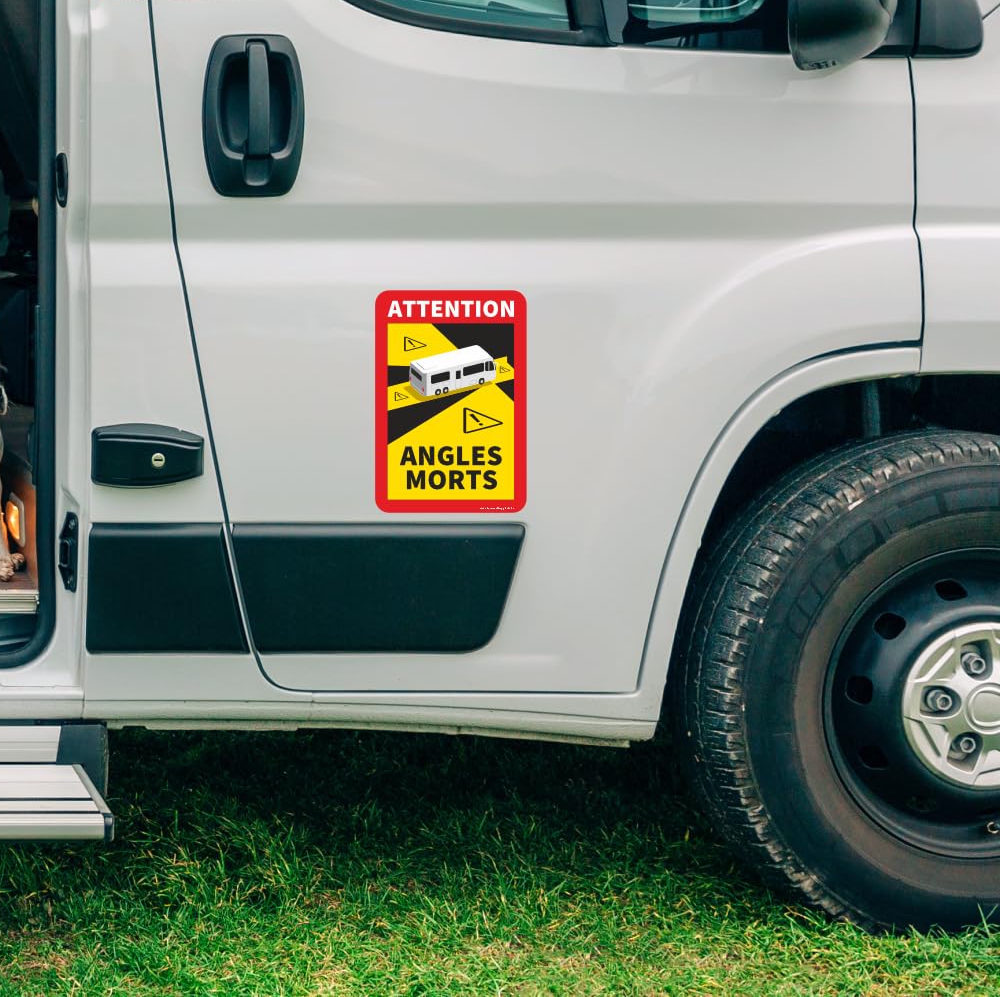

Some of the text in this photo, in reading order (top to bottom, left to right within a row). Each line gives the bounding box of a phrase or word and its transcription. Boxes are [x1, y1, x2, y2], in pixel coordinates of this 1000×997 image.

[387, 300, 515, 318] ATTENTION
[400, 445, 502, 466] ANGLES
[406, 469, 498, 490] MORTS
